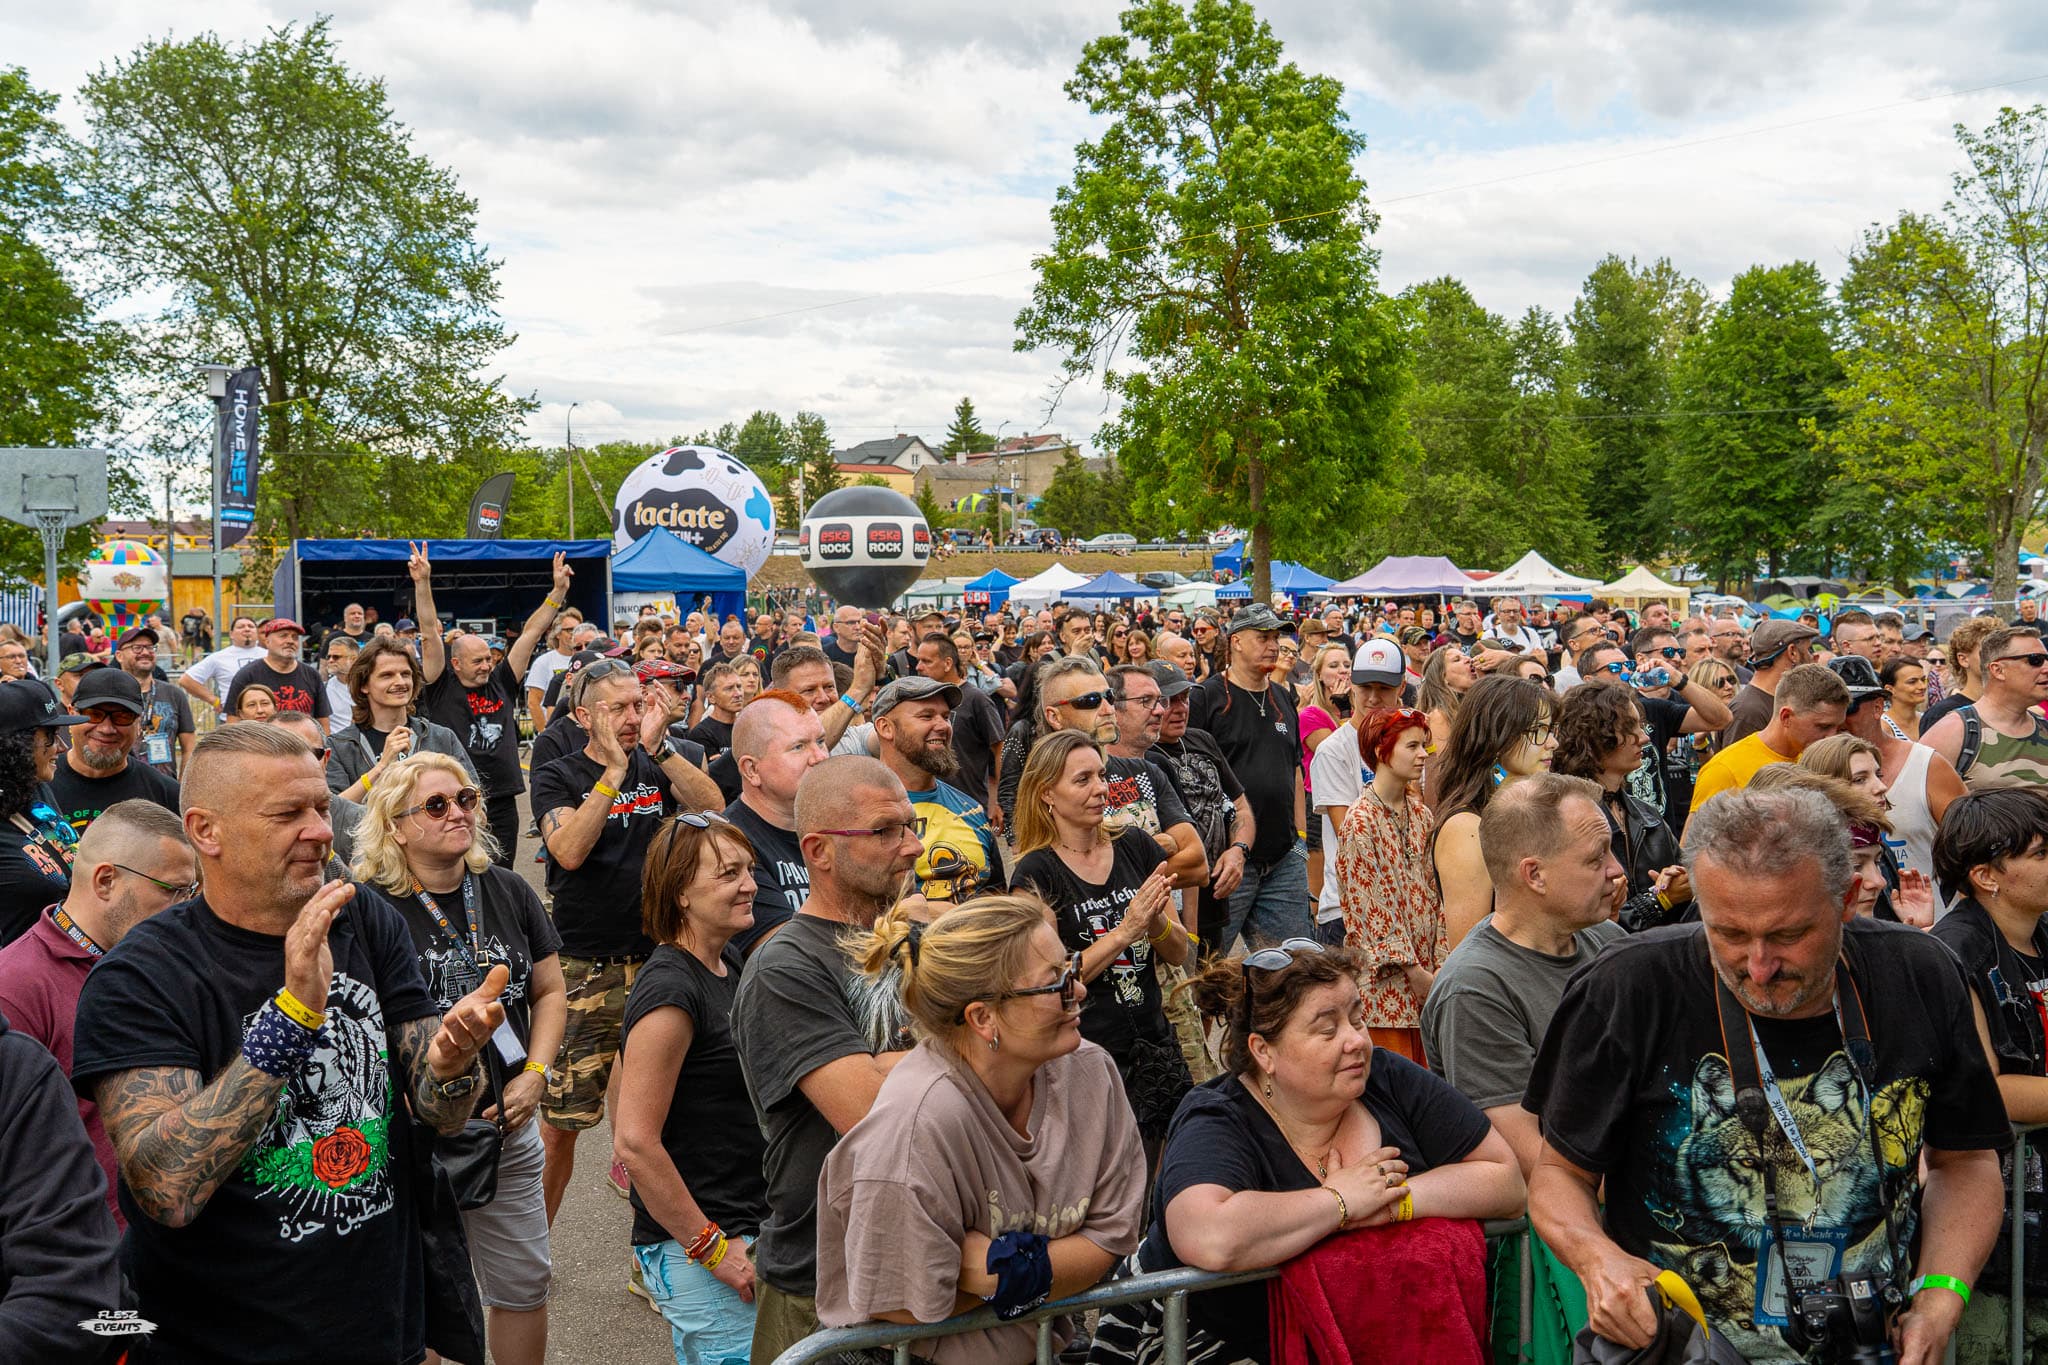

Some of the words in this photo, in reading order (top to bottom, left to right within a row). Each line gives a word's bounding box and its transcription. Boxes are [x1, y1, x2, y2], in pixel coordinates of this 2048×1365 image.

[231, 388, 249, 497] HOMENET
[634, 501, 725, 530] łaciate
[821, 531, 850, 542] eska
[869, 530, 901, 542] eska
[820, 543, 851, 553] ROCK
[868, 543, 902, 553] ROCK
[653, 600, 674, 613] TV
[279, 1215, 326, 1242] حرة
